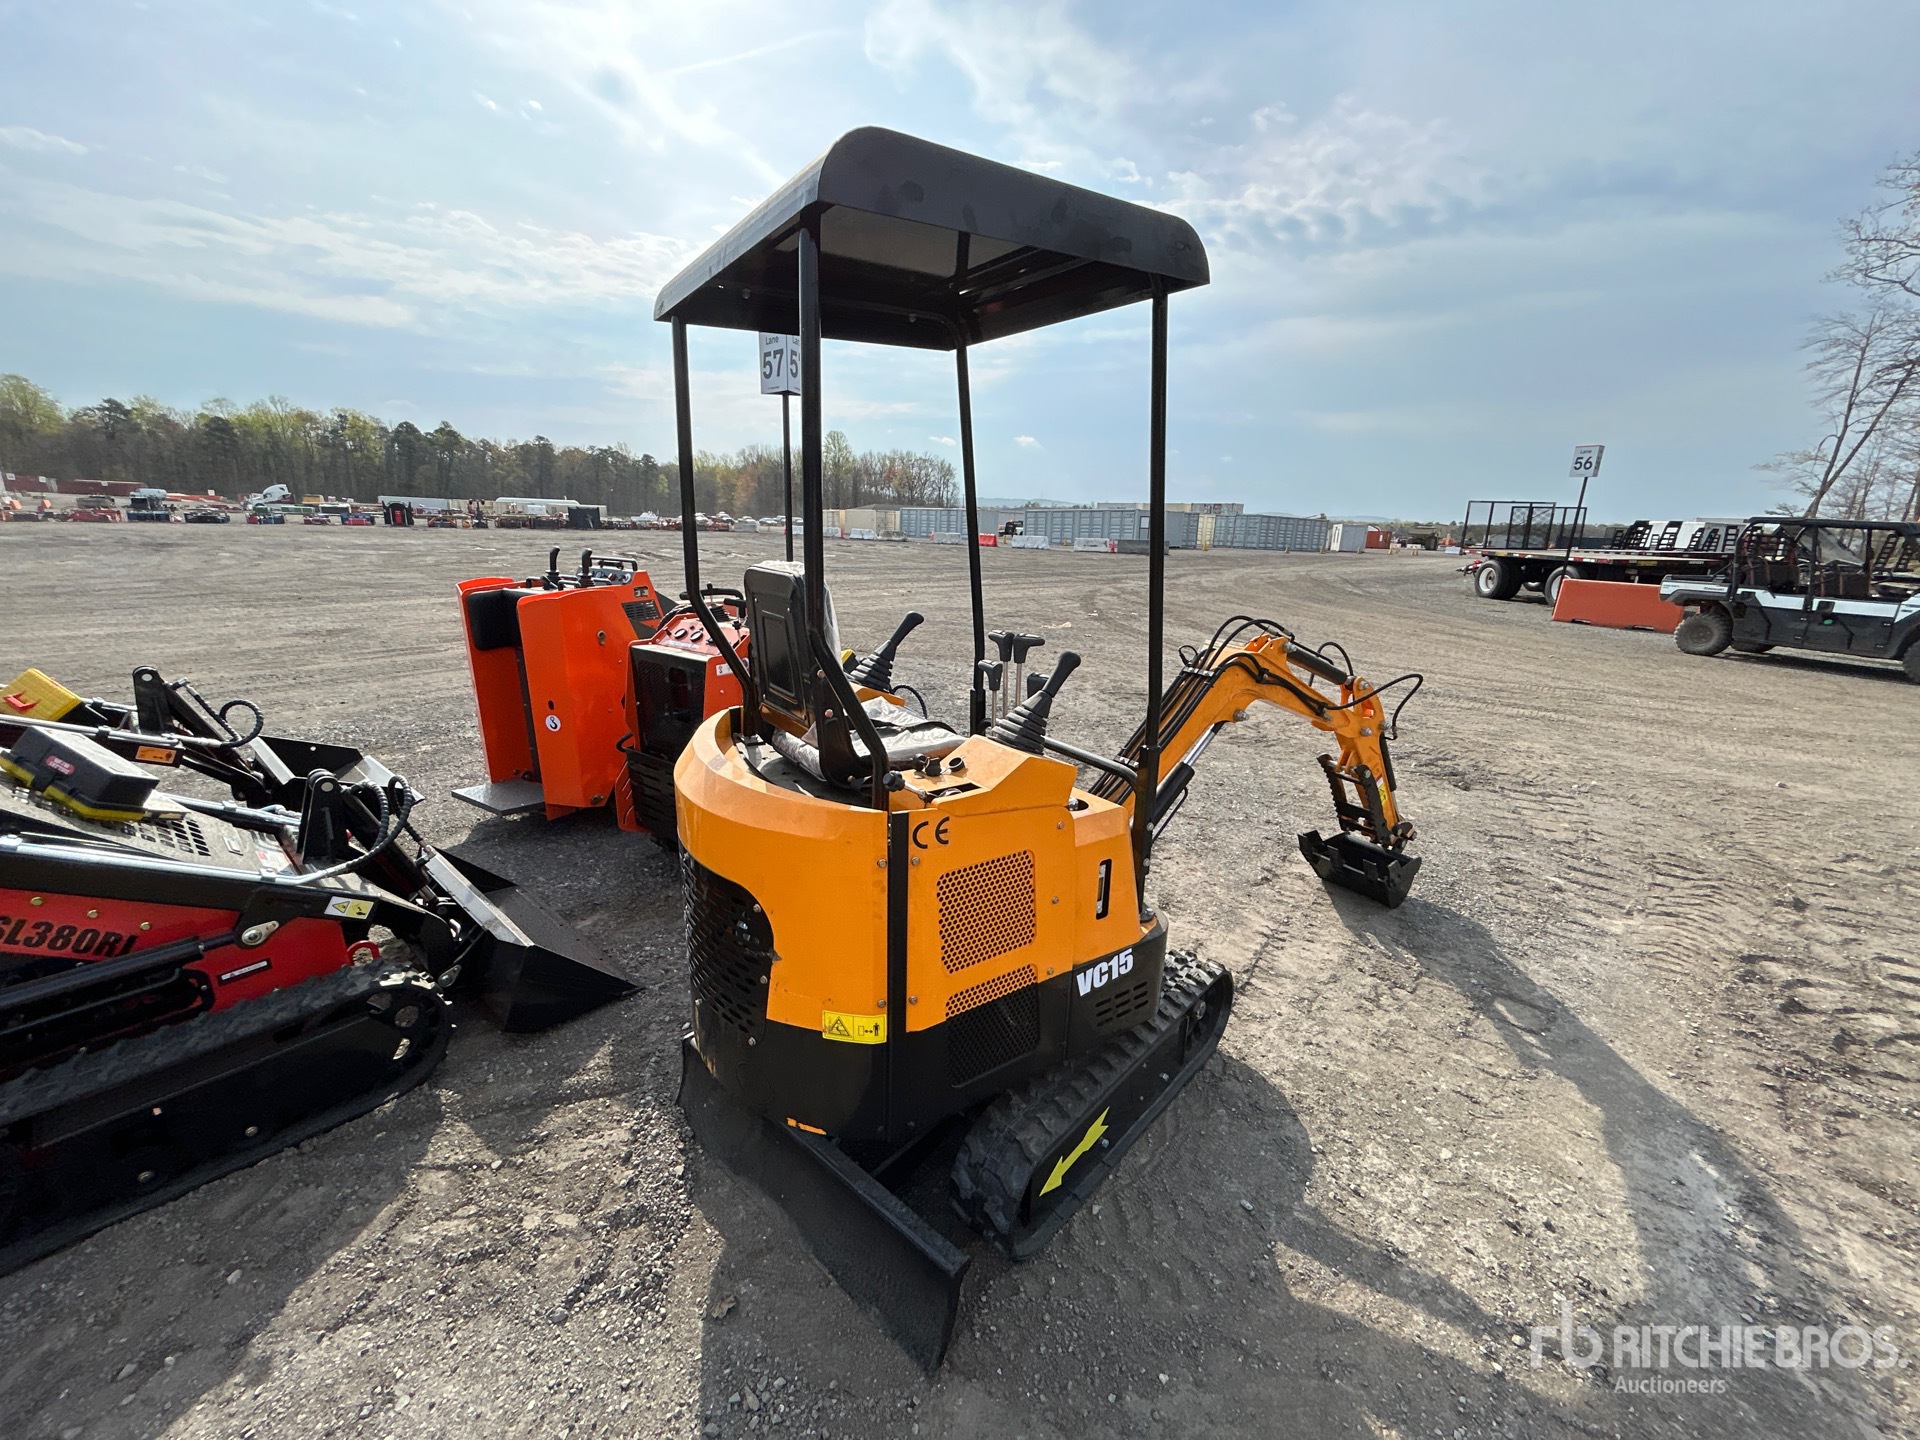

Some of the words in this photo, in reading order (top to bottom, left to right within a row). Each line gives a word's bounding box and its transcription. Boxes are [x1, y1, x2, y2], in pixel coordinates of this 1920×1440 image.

[765, 336, 779, 345] Lane
[763, 349, 784, 379] 57
[790, 349, 800, 378] 5
[1573, 456, 1593, 470] 56
[912, 816, 950, 849] CE
[1076, 948, 1134, 996] VC15
